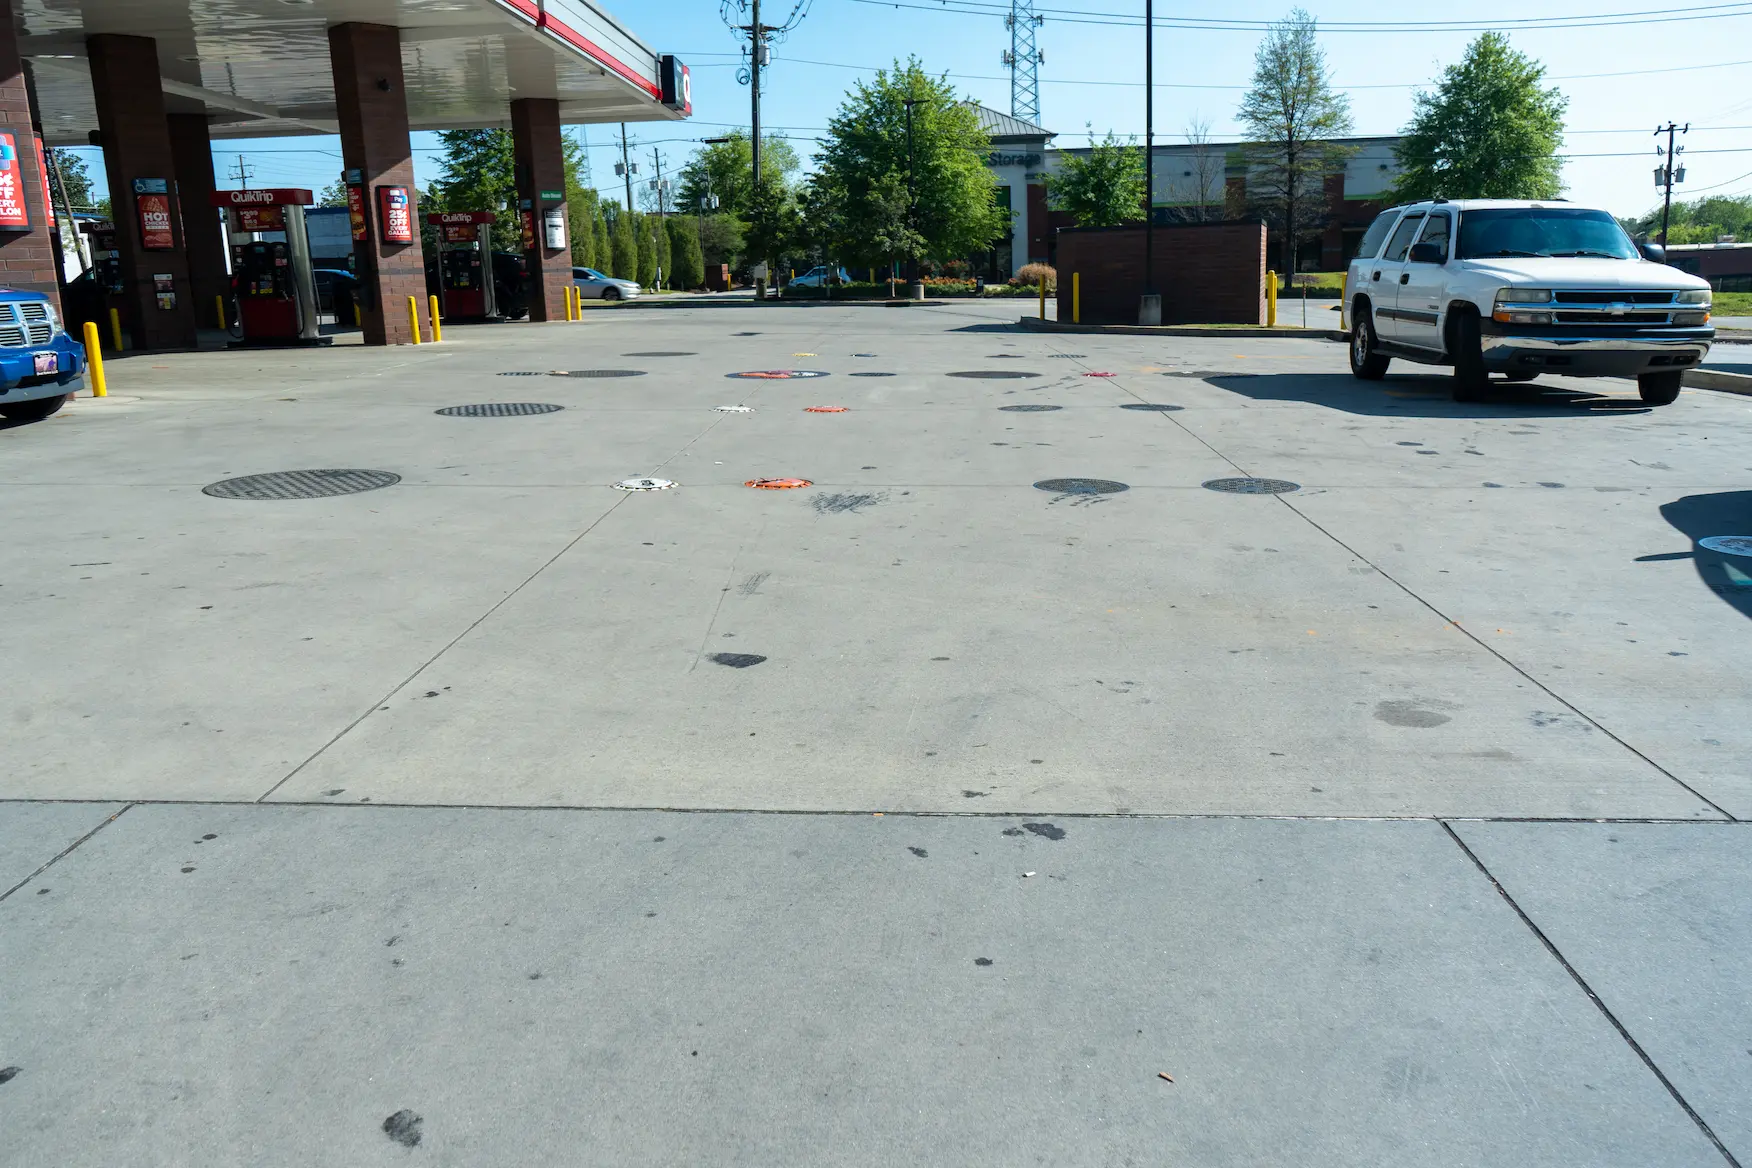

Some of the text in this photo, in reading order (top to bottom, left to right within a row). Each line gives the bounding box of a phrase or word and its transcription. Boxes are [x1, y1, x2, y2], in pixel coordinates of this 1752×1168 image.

[989, 152, 1041, 168] Storage
[231, 191, 274, 204] QuikTrip
[143, 212, 169, 222] HOT
[441, 213, 472, 223] QuikTrip
